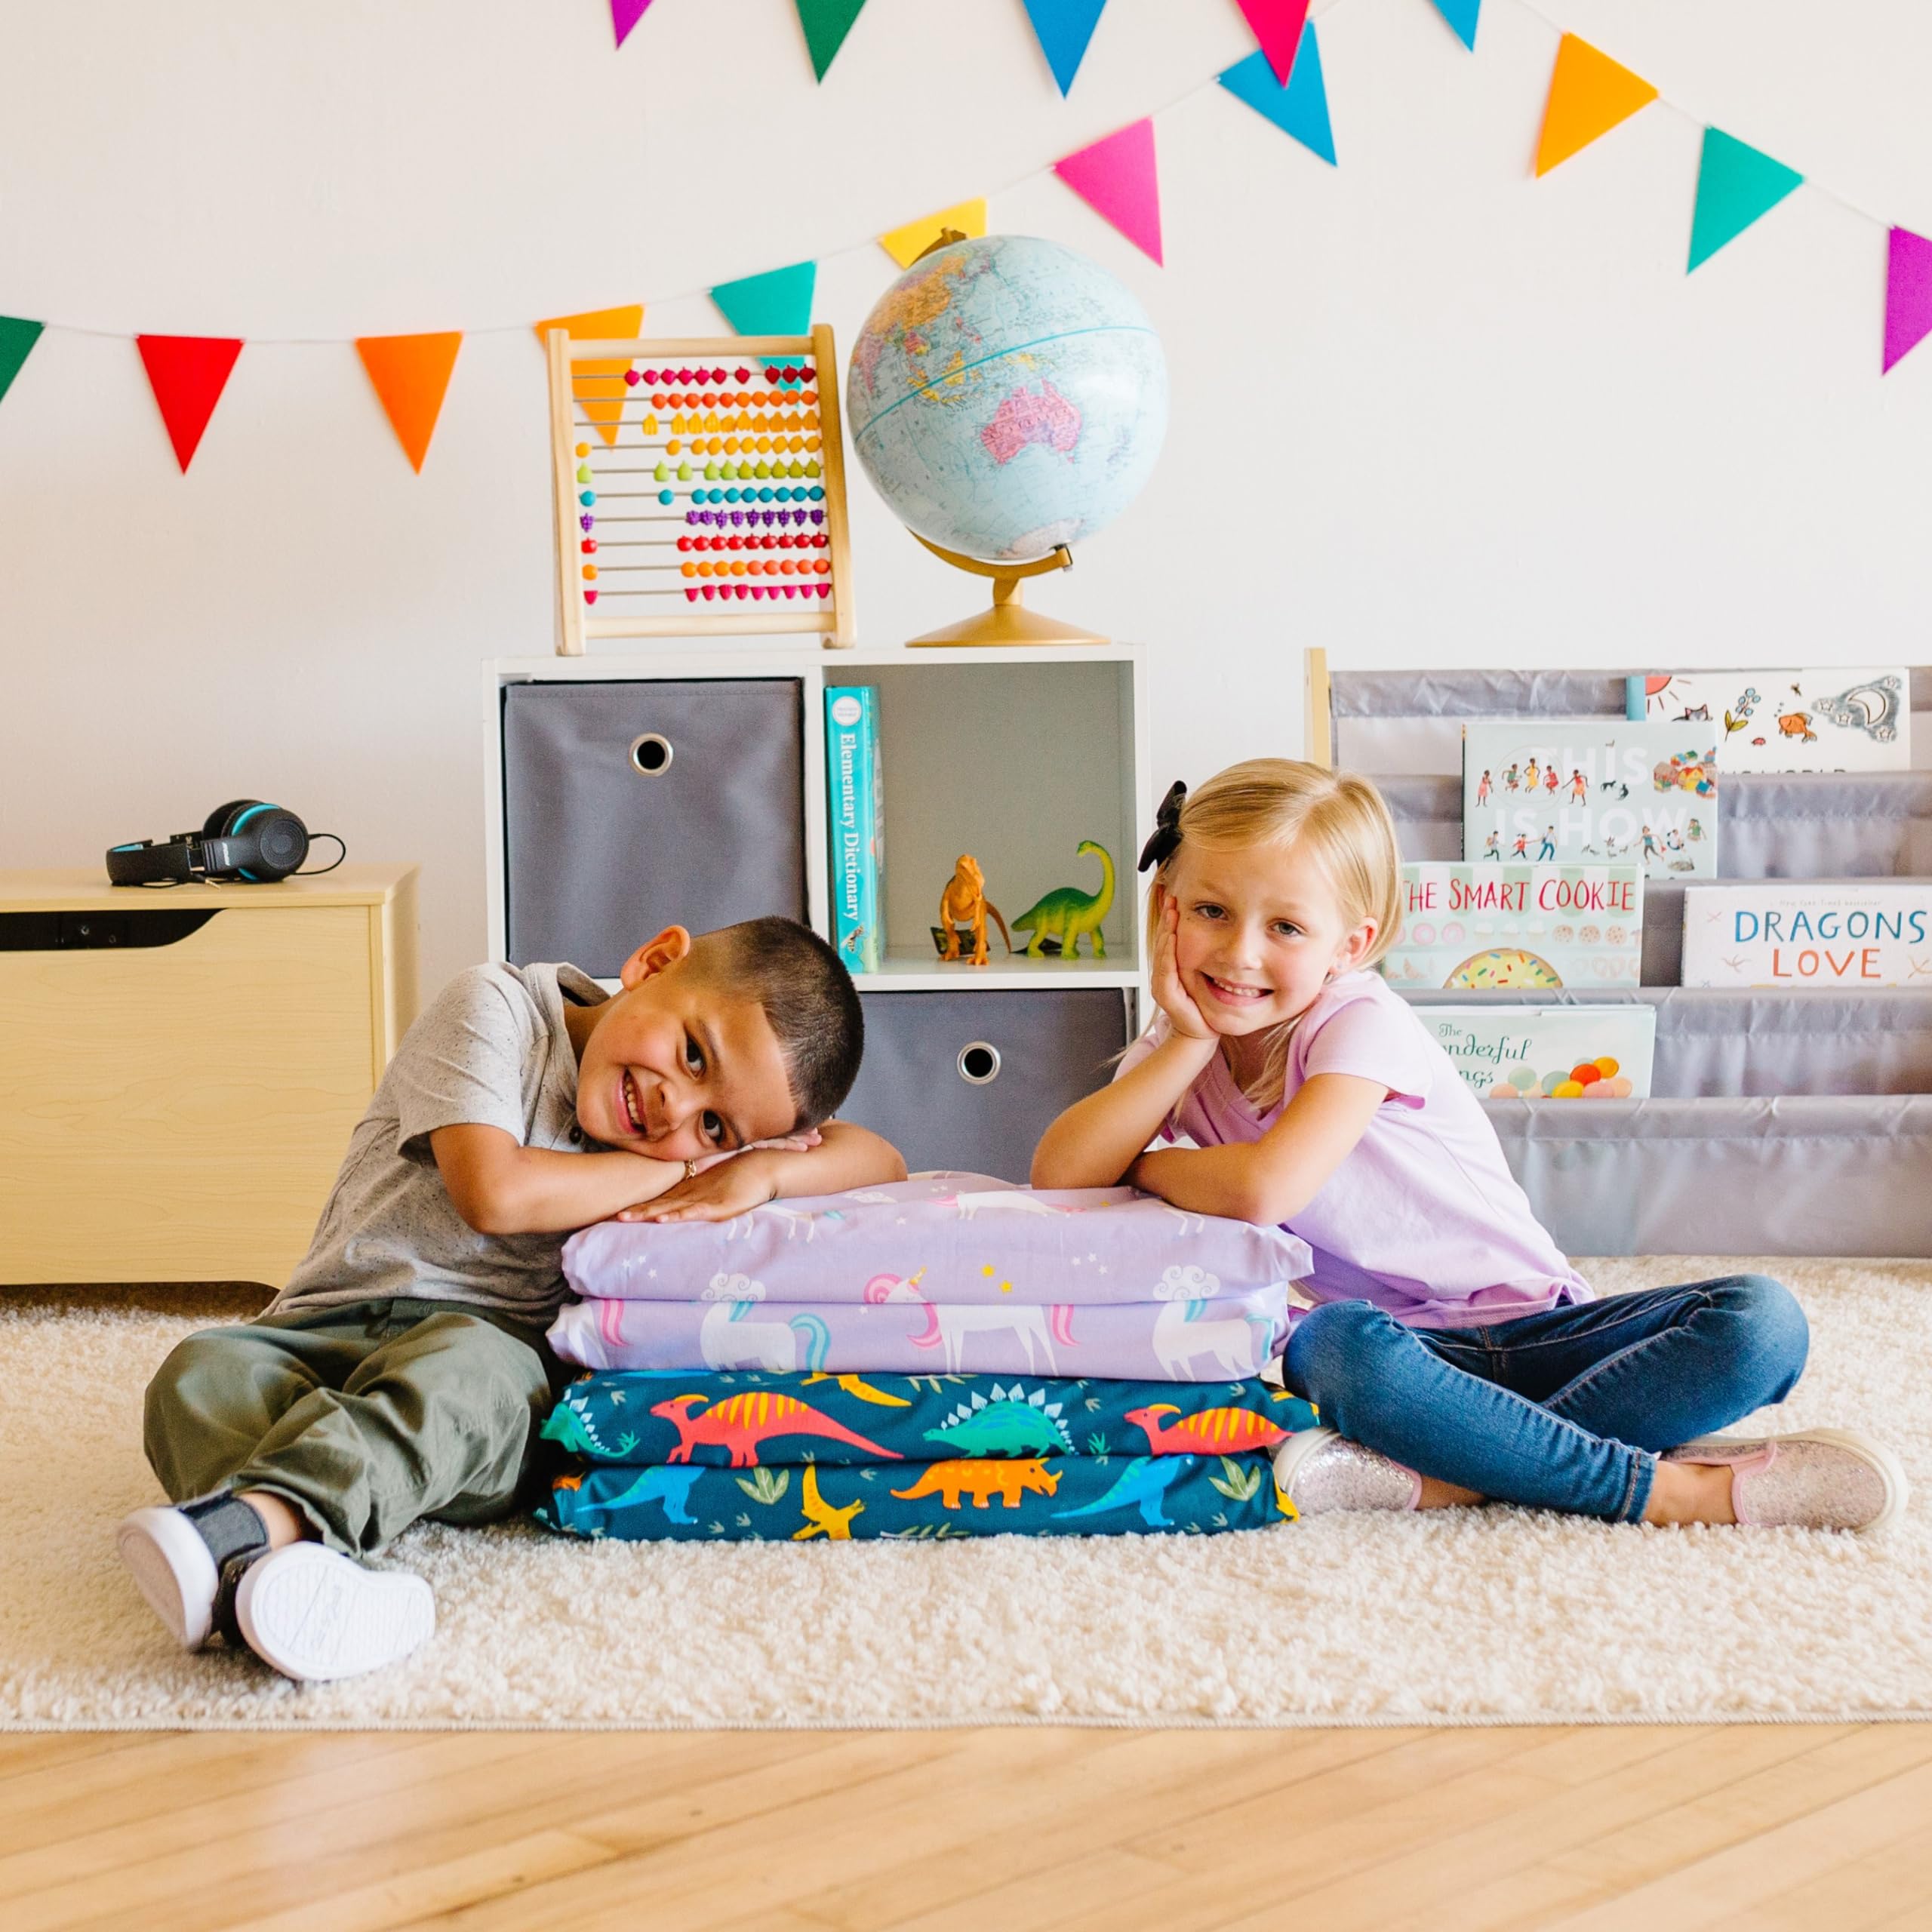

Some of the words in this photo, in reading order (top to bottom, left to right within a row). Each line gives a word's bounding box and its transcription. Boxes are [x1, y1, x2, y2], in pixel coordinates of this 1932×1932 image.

[839, 733, 857, 829] Elementary
[1531, 747, 1649, 786] THIS
[1495, 807, 1539, 846] IS
[1558, 807, 1688, 846] HOW
[843, 832, 860, 921] Dictionary
[1448, 878, 1531, 912] SMART
[1538, 878, 1635, 912] COOKIE
[1734, 910, 1928, 944] DRAGONS
[1773, 948, 1882, 979] LOVE
[1438, 1023, 1463, 1038] The
[1442, 1032, 1533, 1065] nderful
